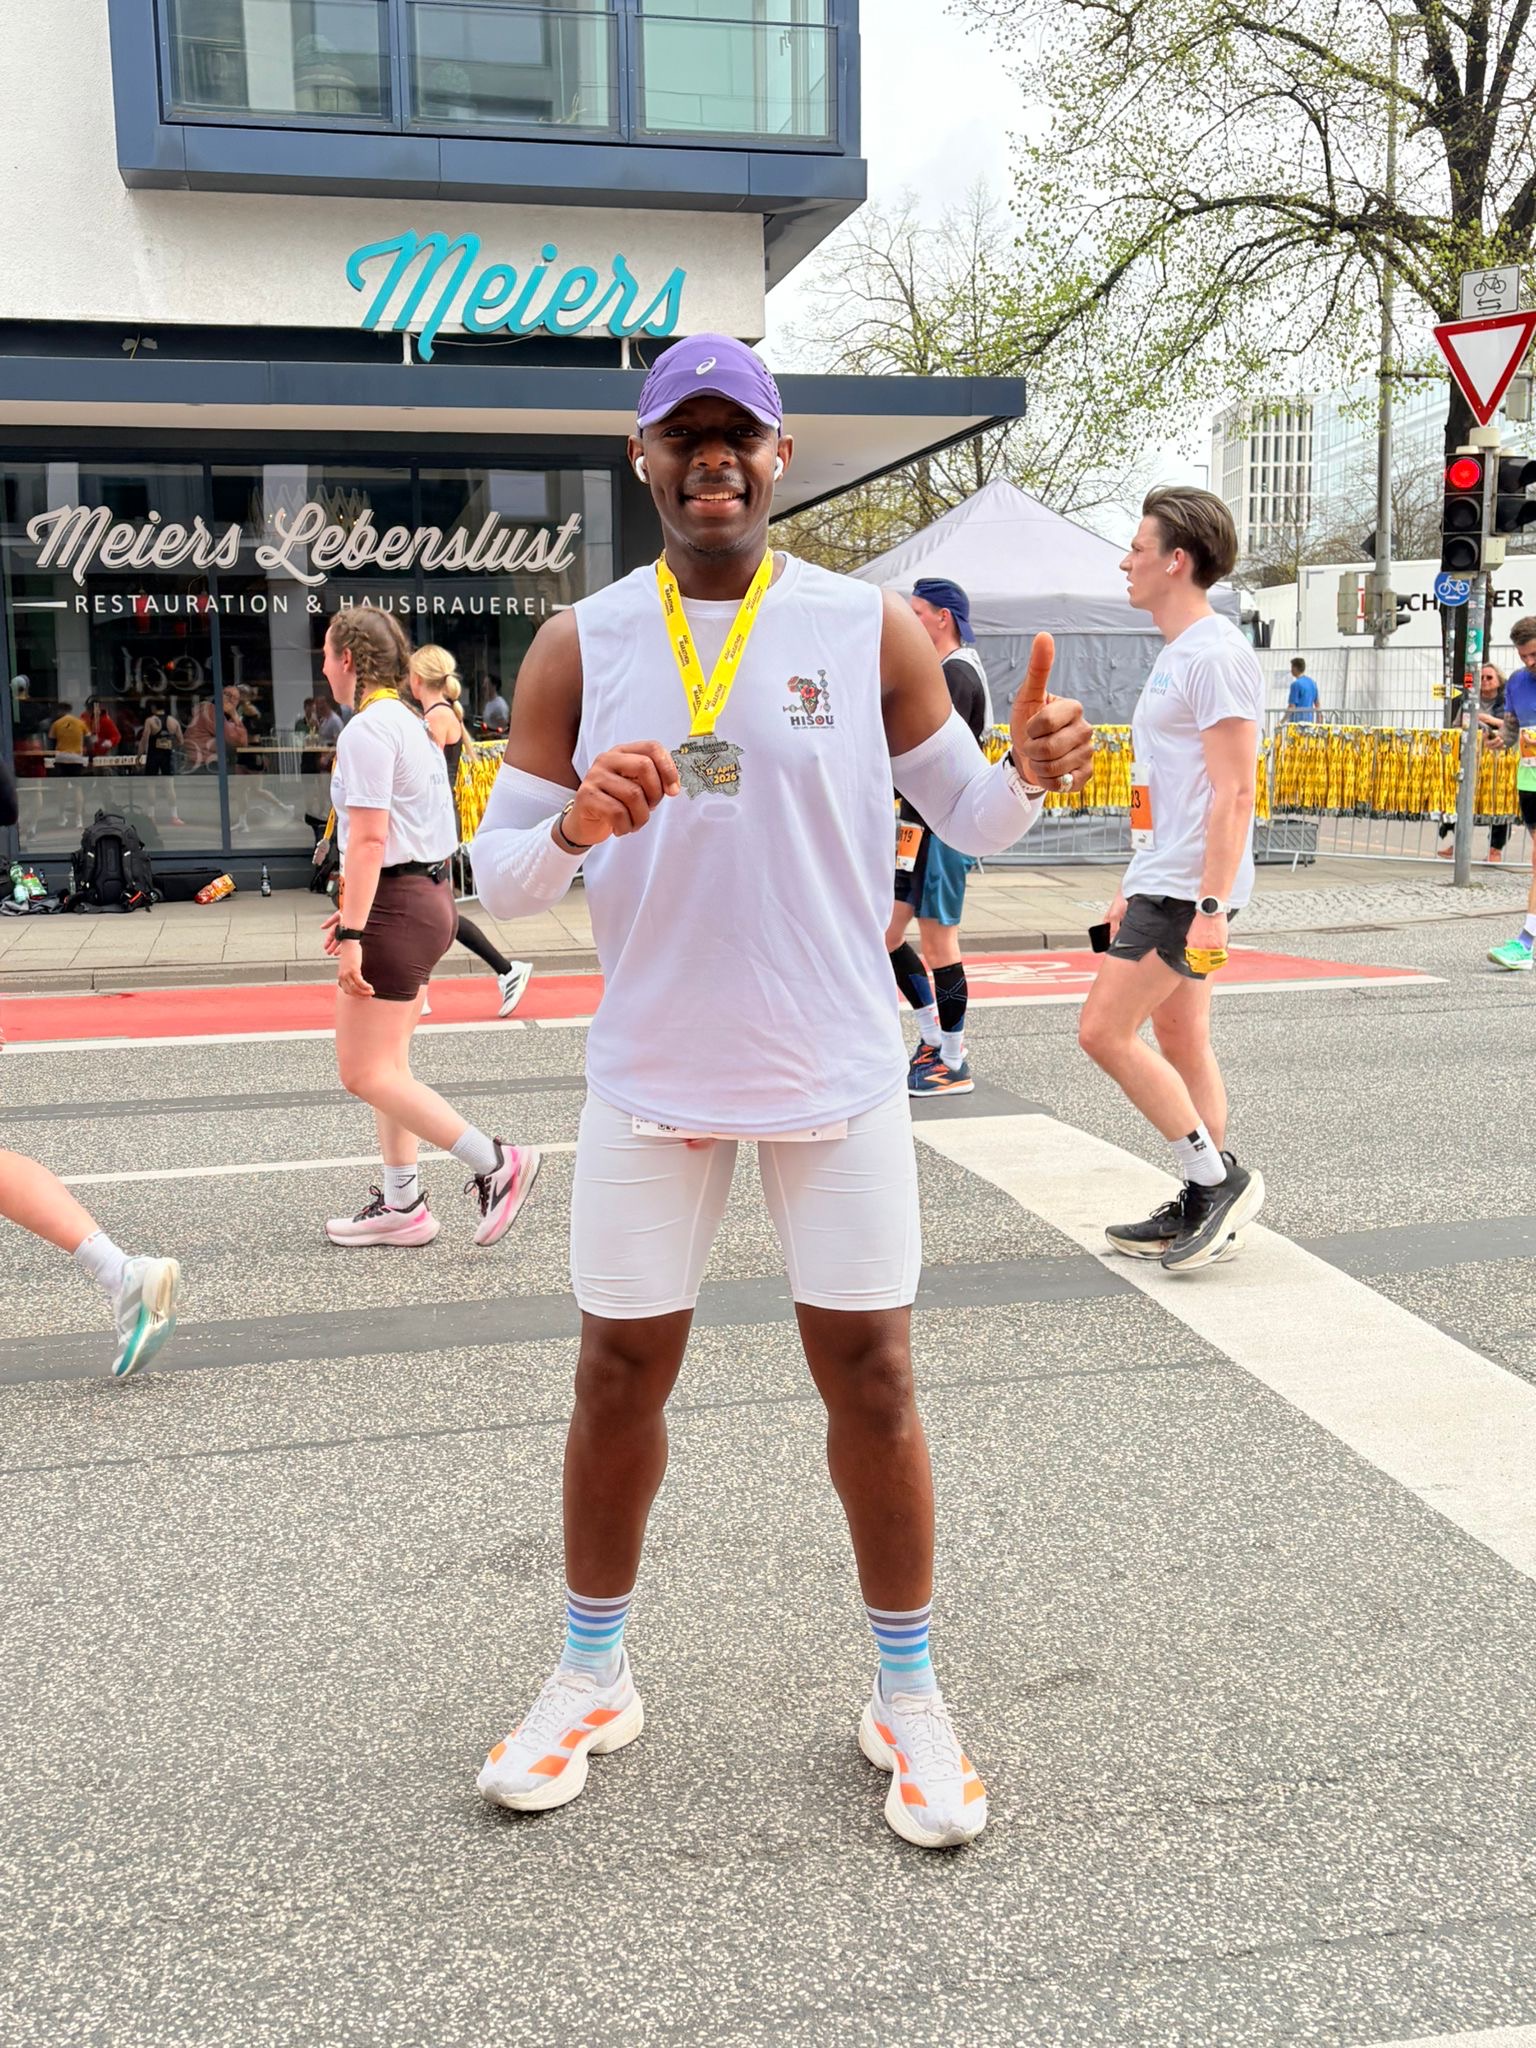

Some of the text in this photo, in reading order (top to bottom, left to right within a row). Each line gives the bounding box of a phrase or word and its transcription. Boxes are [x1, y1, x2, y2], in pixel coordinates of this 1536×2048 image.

[346, 228, 687, 362] Meiers
[26, 502, 583, 587] Meiers Lebenslust
[75, 594, 546, 615] RESTAURATION & HAUSBRAUEREI
[790, 715, 834, 726] HISOU
[713, 773, 738, 785] 2026
